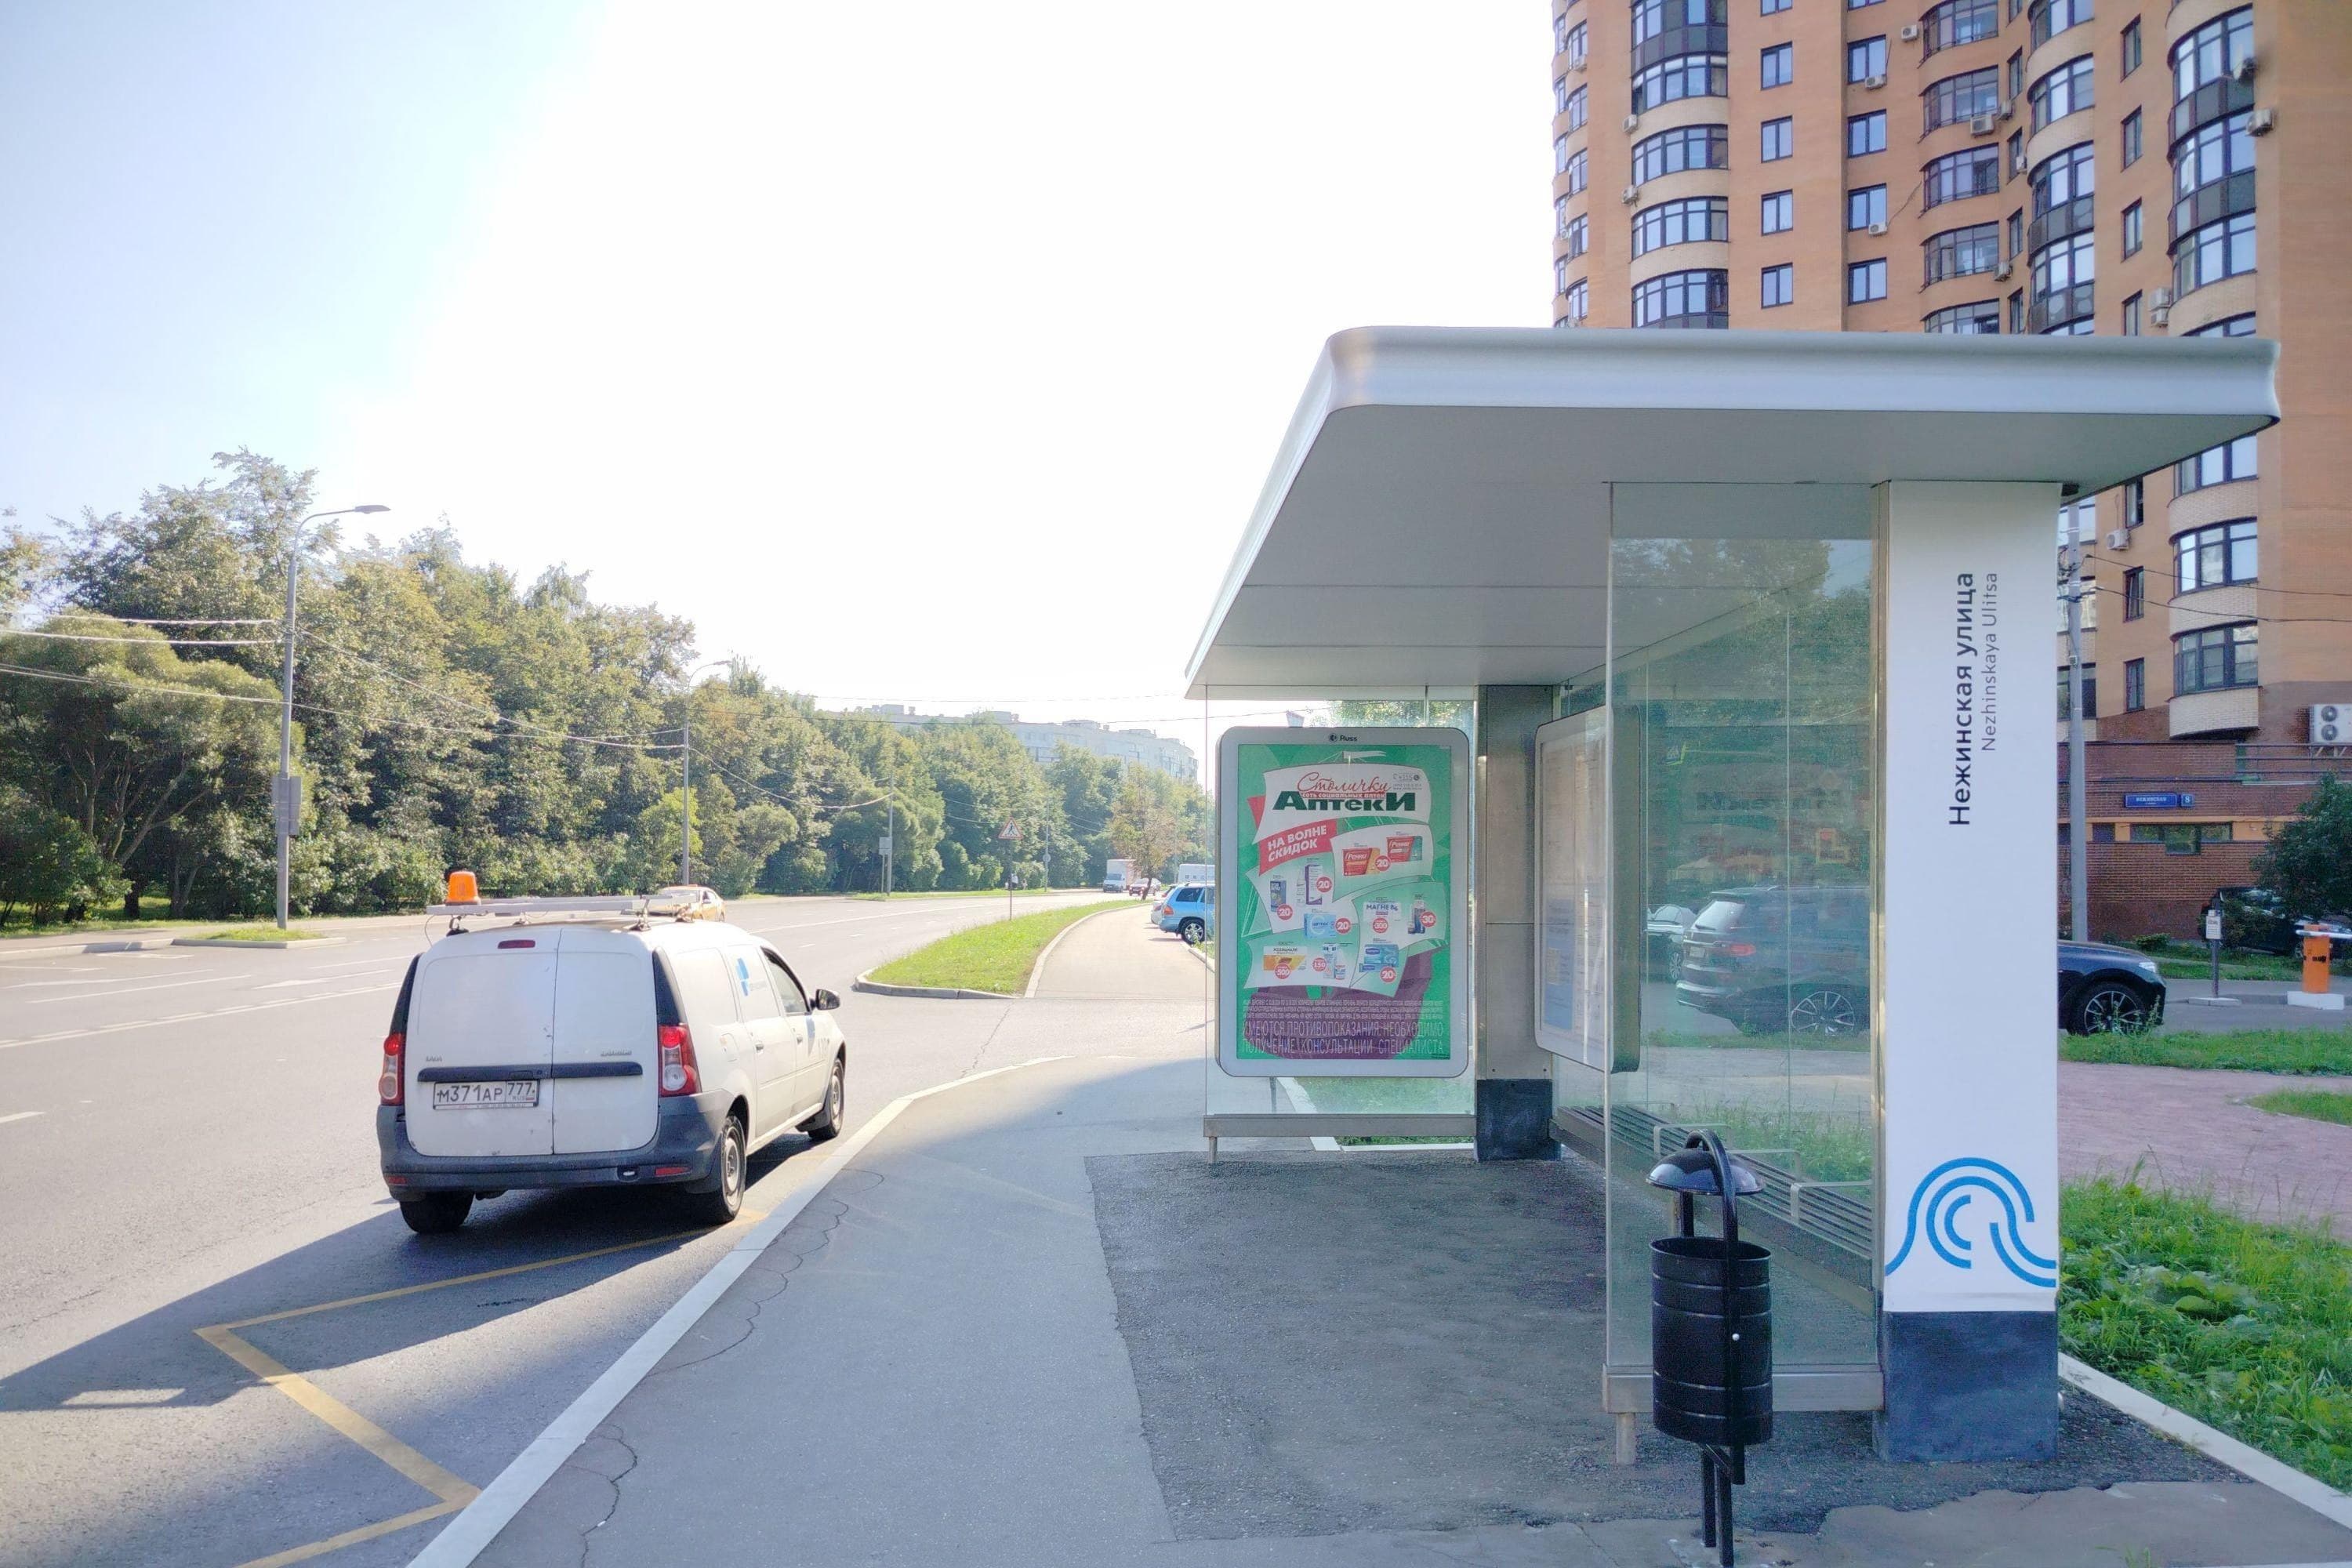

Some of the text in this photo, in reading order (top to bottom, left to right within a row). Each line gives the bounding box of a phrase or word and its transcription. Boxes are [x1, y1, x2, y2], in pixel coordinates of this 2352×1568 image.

[1981, 572, 2000, 752] Nezhinskaya Ulitsa
[1948, 572, 1978, 826] Нежинская улица
[1297, 771, 1392, 792] Столички
[1268, 825, 1327, 851] НА ВОЛНЕ
[1267, 838, 1318, 862] СКИДОК
[1243, 1020, 1285, 1036] ИМЕЮТСЯ
[1383, 1022, 1443, 1036] НЕОБХОДИМО
[1243, 1038, 1443, 1056] ПОЛУЧЕНИЕ КОНСУЛЬТАЦИИ СПЕЦИАЛИСТА
[507, 1082, 532, 1096] 777
